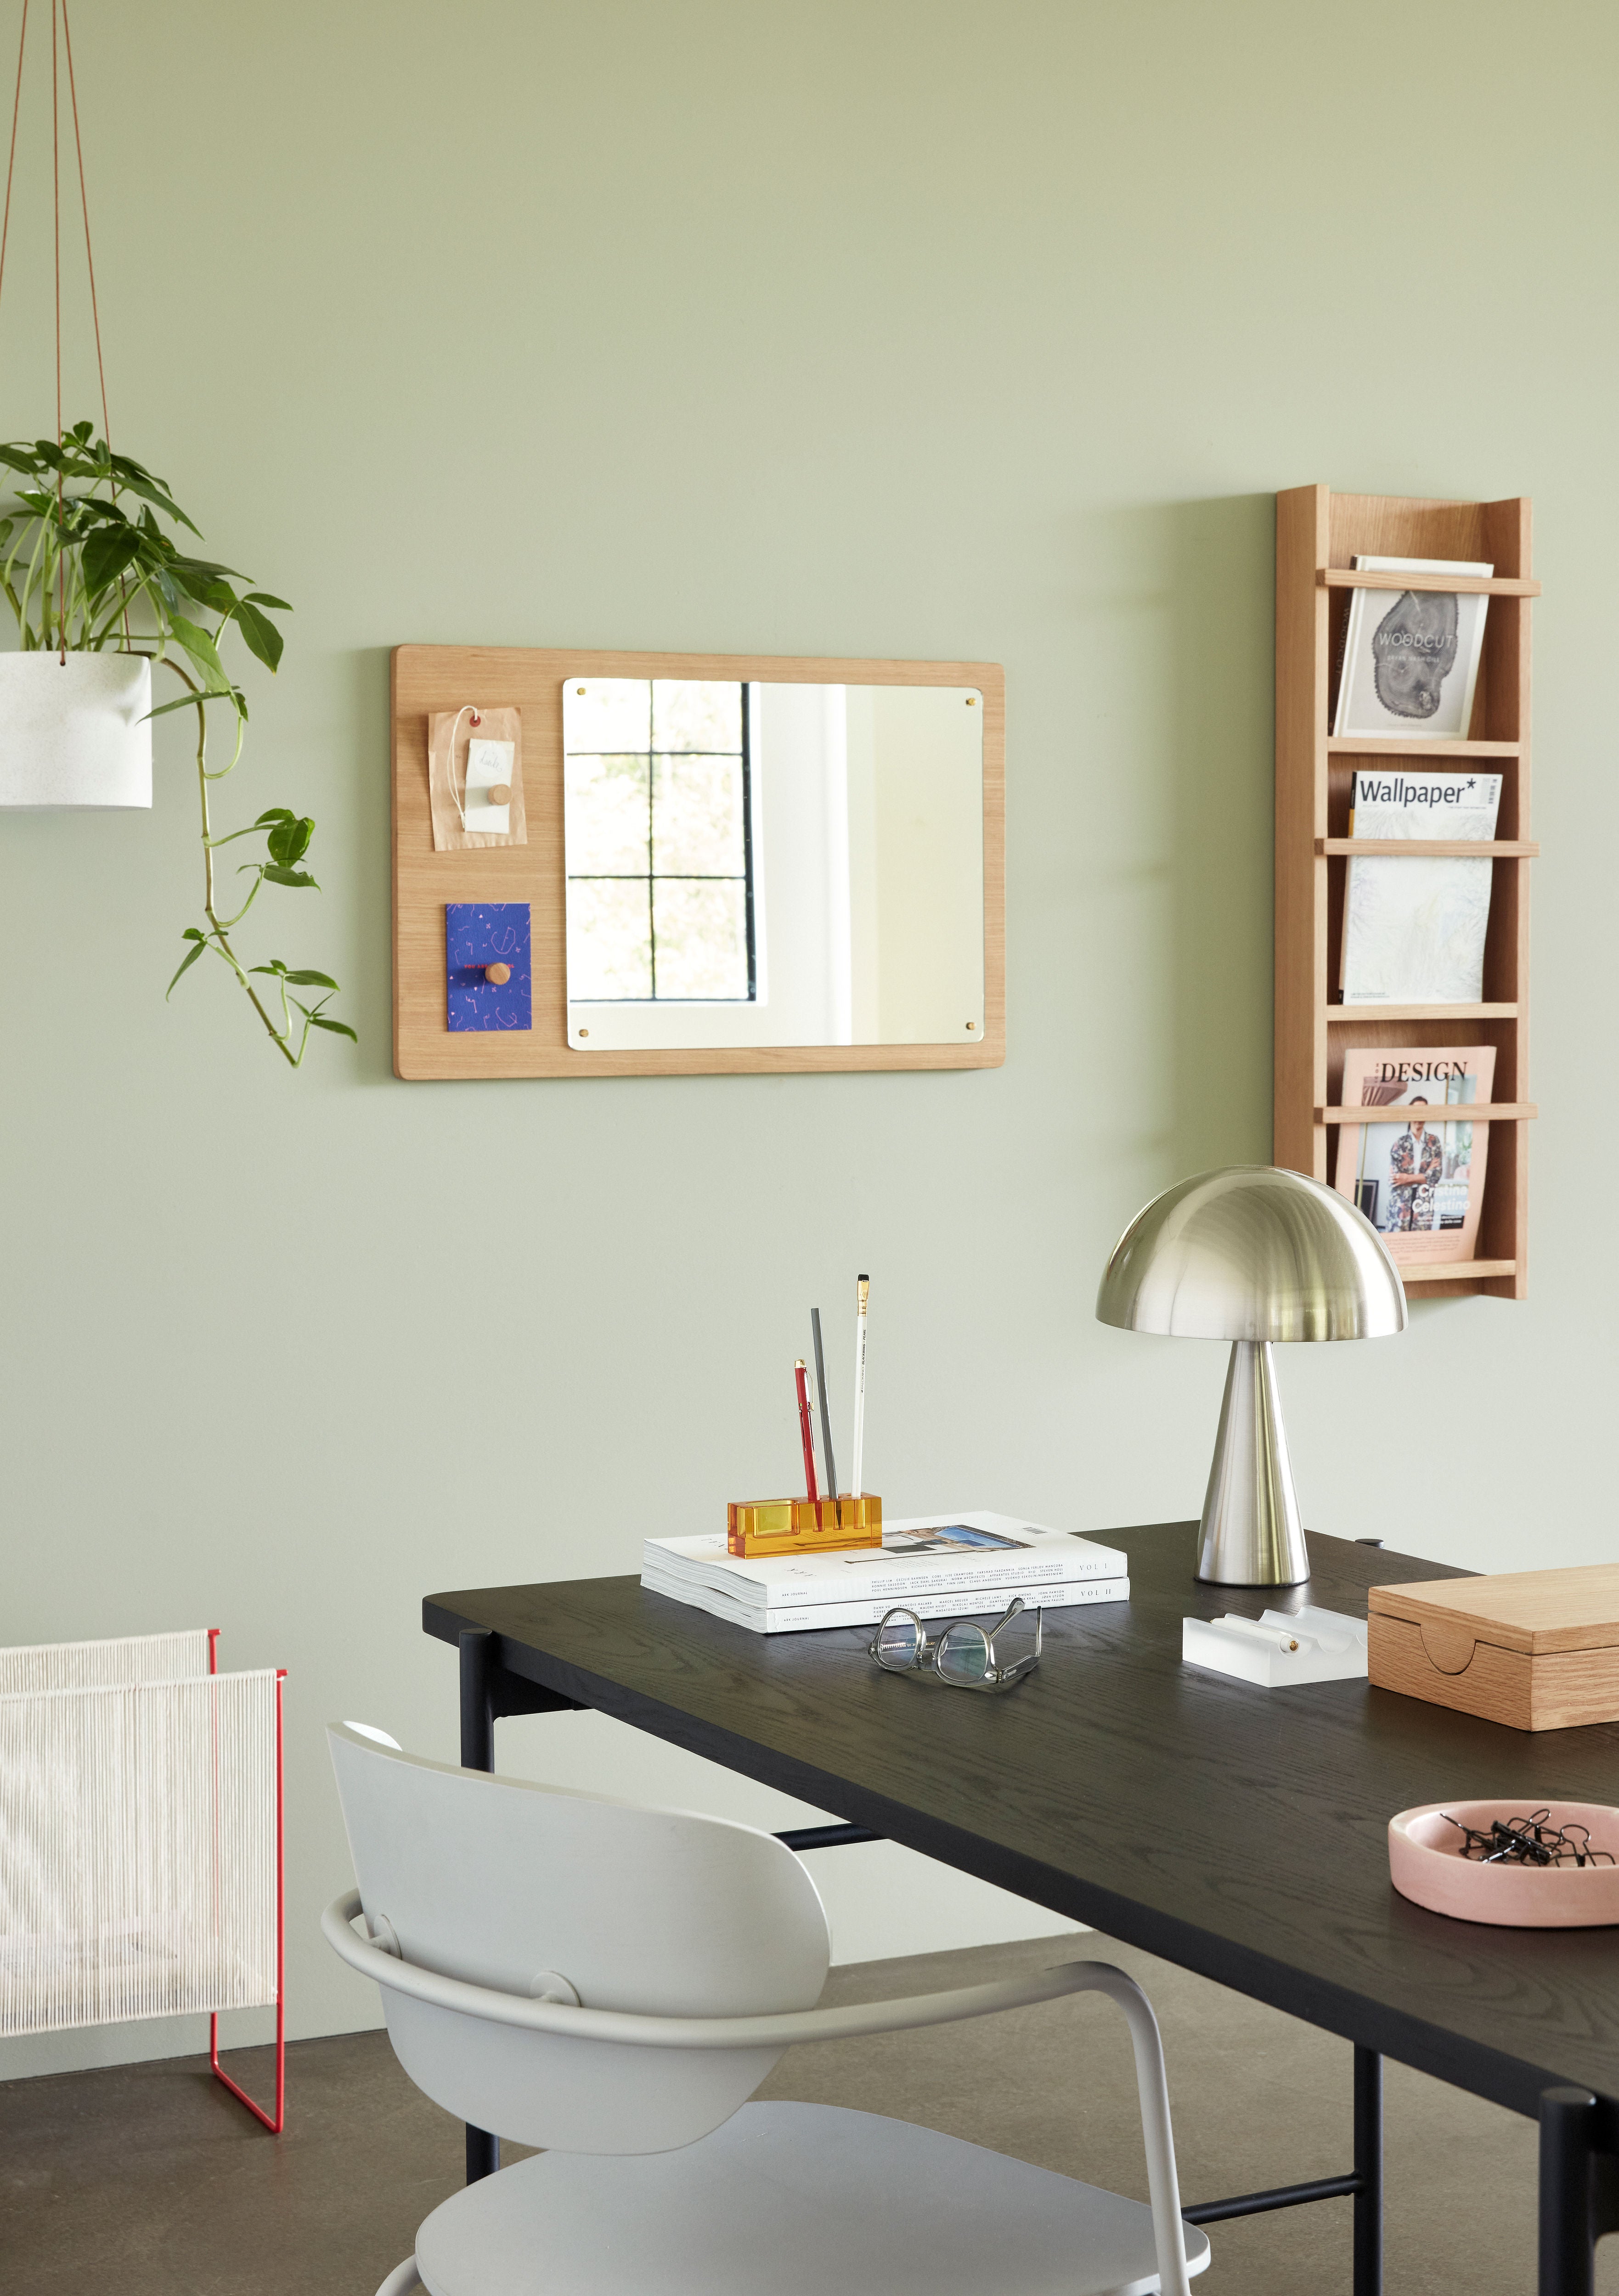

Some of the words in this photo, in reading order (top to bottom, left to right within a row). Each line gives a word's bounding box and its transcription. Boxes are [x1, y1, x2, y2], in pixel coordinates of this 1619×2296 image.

[1379, 633, 1453, 647] WOODCUT
[1380, 1062, 1468, 1083] DESIGN
[1412, 1198, 1471, 1212] Celestino
